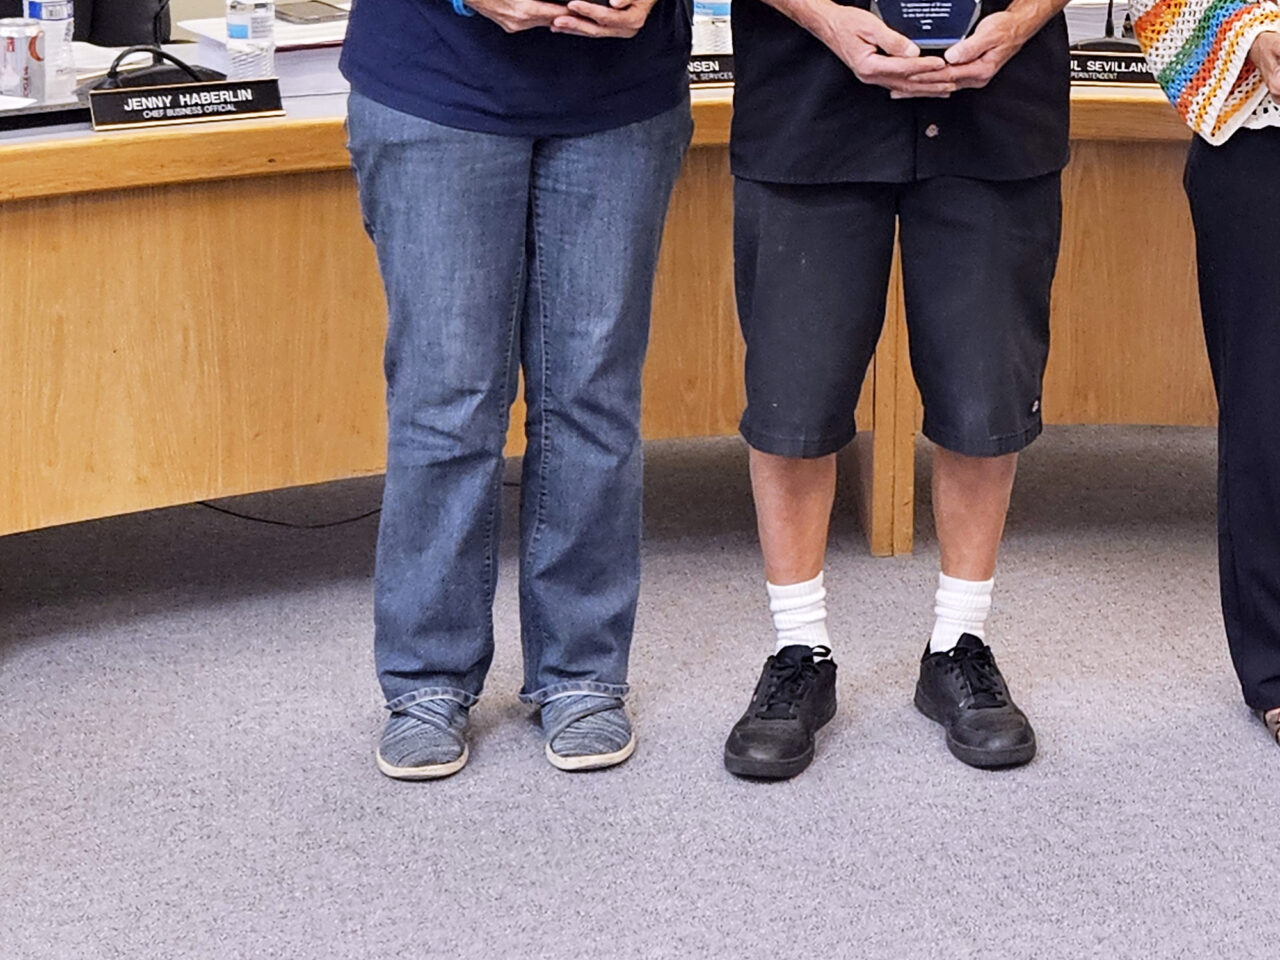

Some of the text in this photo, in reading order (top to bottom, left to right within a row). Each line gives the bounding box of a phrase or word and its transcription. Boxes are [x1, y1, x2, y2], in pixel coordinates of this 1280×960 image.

[700, 71, 734, 81] SERVICES
[124, 88, 253, 111] JENNY HABERLIN
[143, 103, 237, 119] CHIEF BUSINESS OFFICIAL
